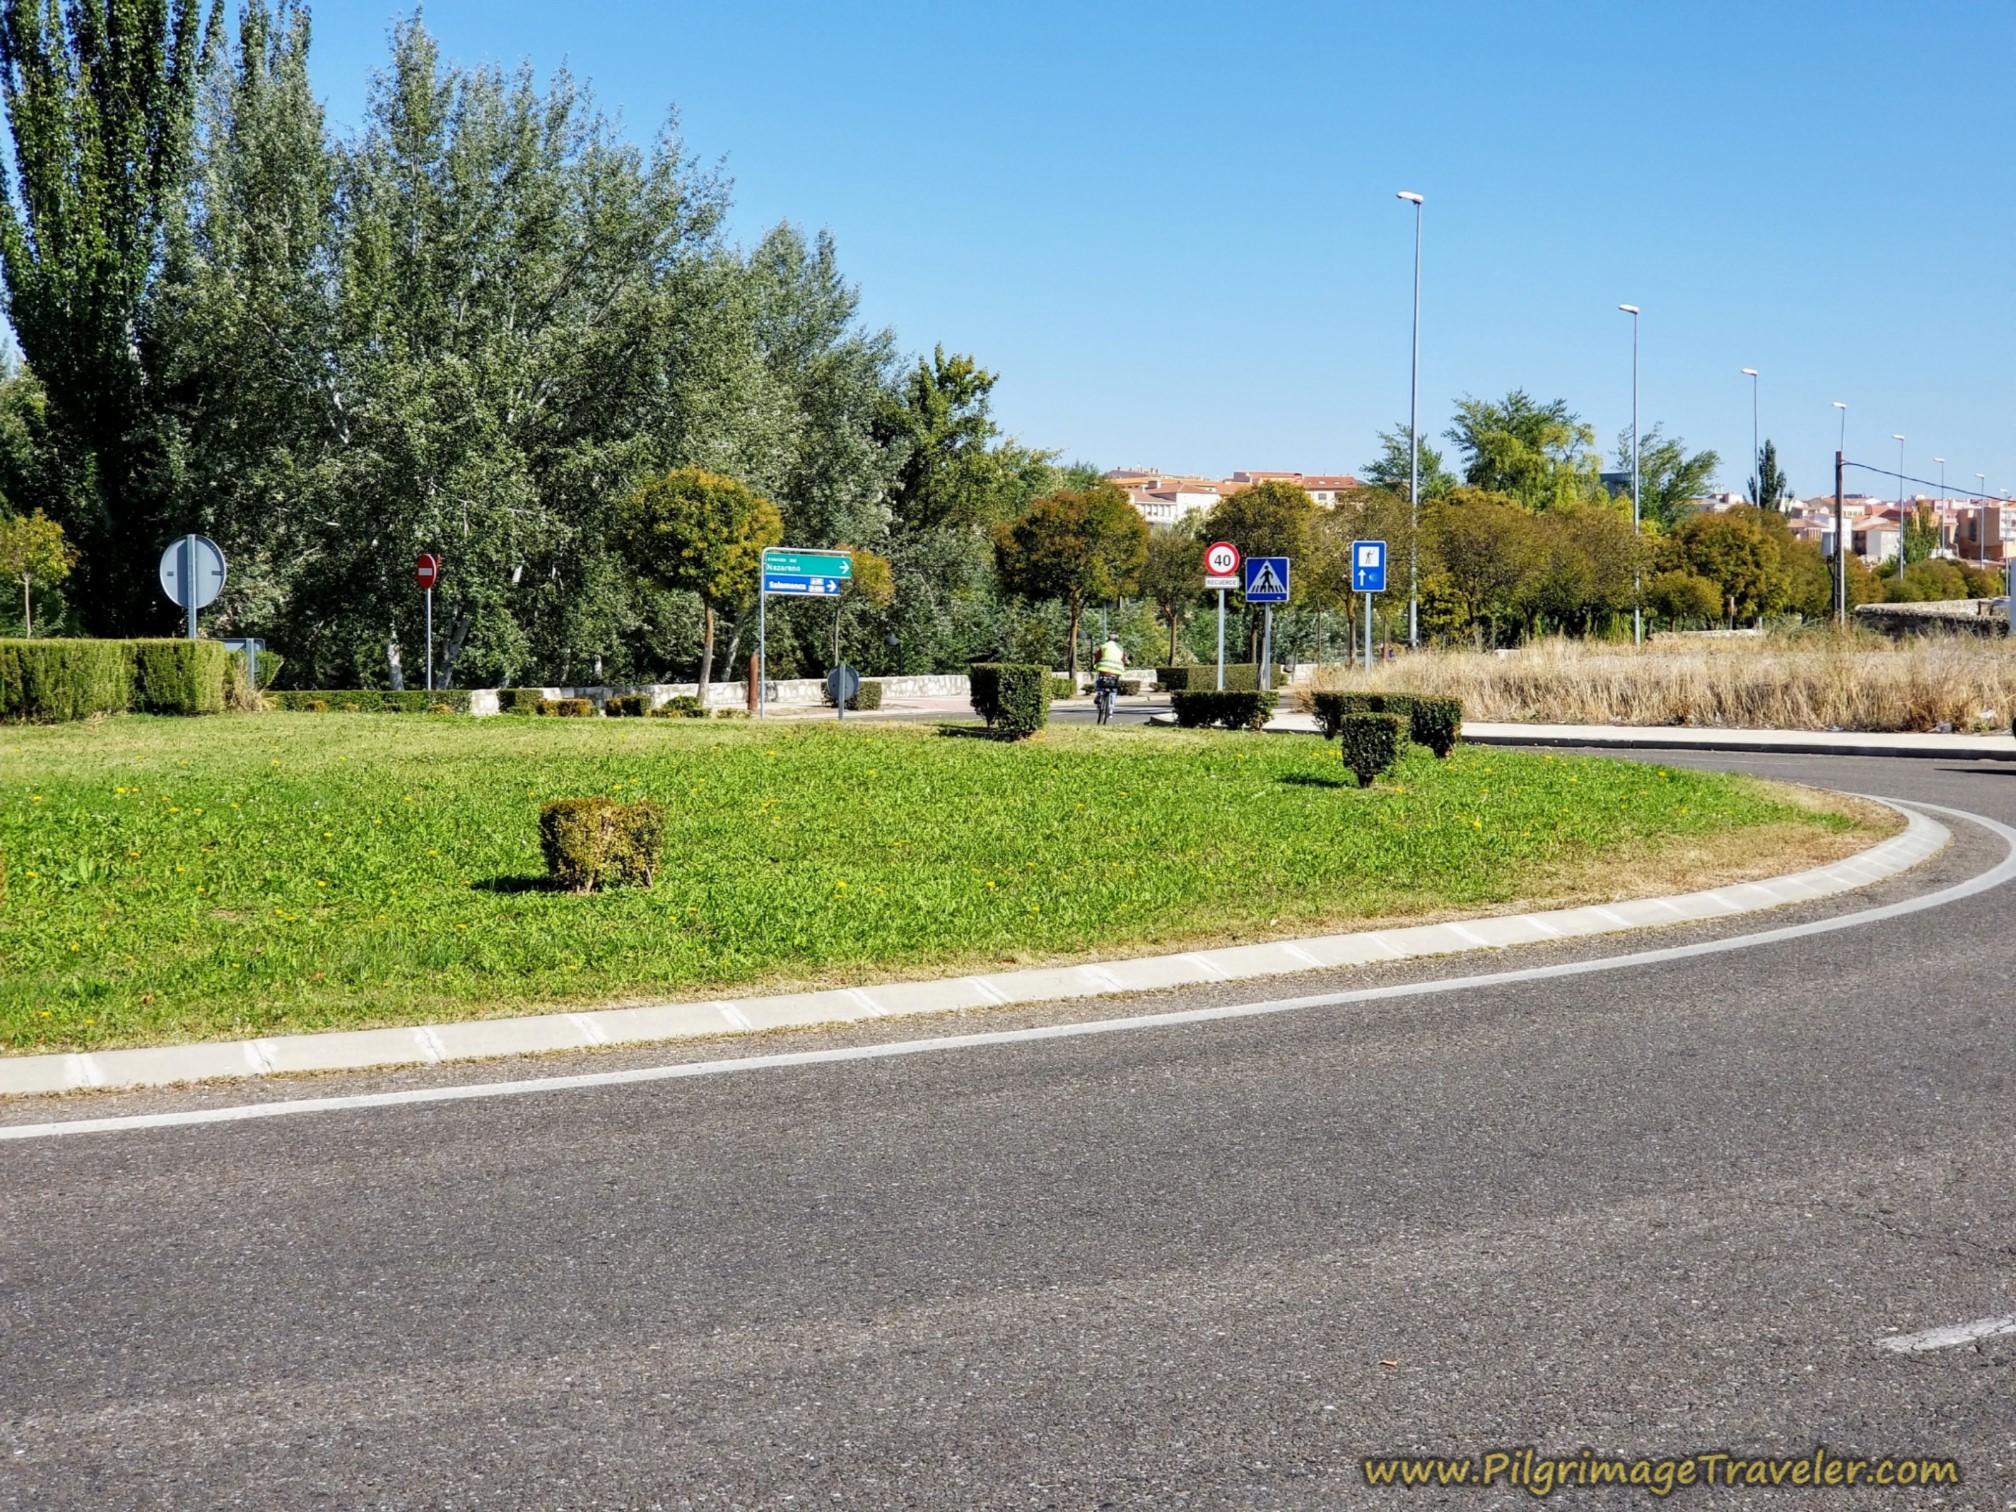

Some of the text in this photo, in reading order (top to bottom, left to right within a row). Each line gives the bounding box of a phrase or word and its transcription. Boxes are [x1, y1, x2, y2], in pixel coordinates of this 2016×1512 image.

[1214, 554, 1231, 566] 40
[766, 563, 801, 572] Nazareno
[769, 580, 807, 591] Salamanca
